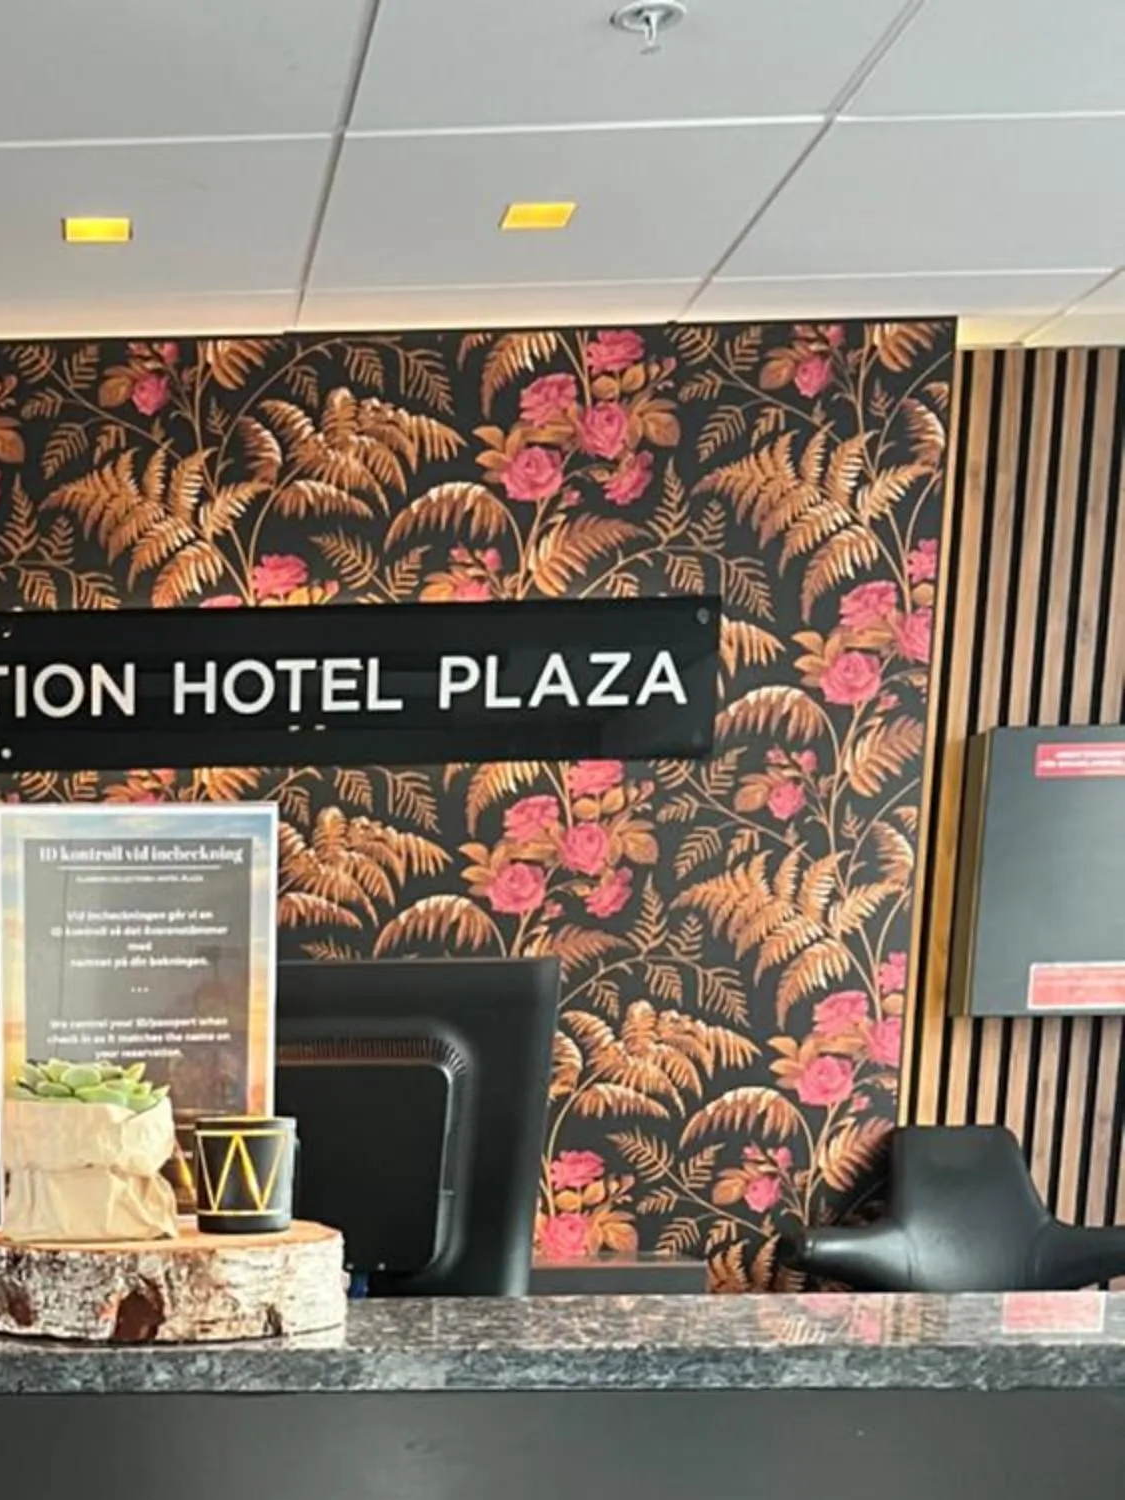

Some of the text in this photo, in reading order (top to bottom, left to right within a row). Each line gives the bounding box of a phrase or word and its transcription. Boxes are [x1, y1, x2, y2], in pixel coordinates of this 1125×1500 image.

[174, 657, 403, 715] HOTEL
[438, 651, 688, 710] PLAZA
[39, 846, 58, 861] ID
[60, 845, 123, 861] kontroll
[124, 844, 149, 861] vid
